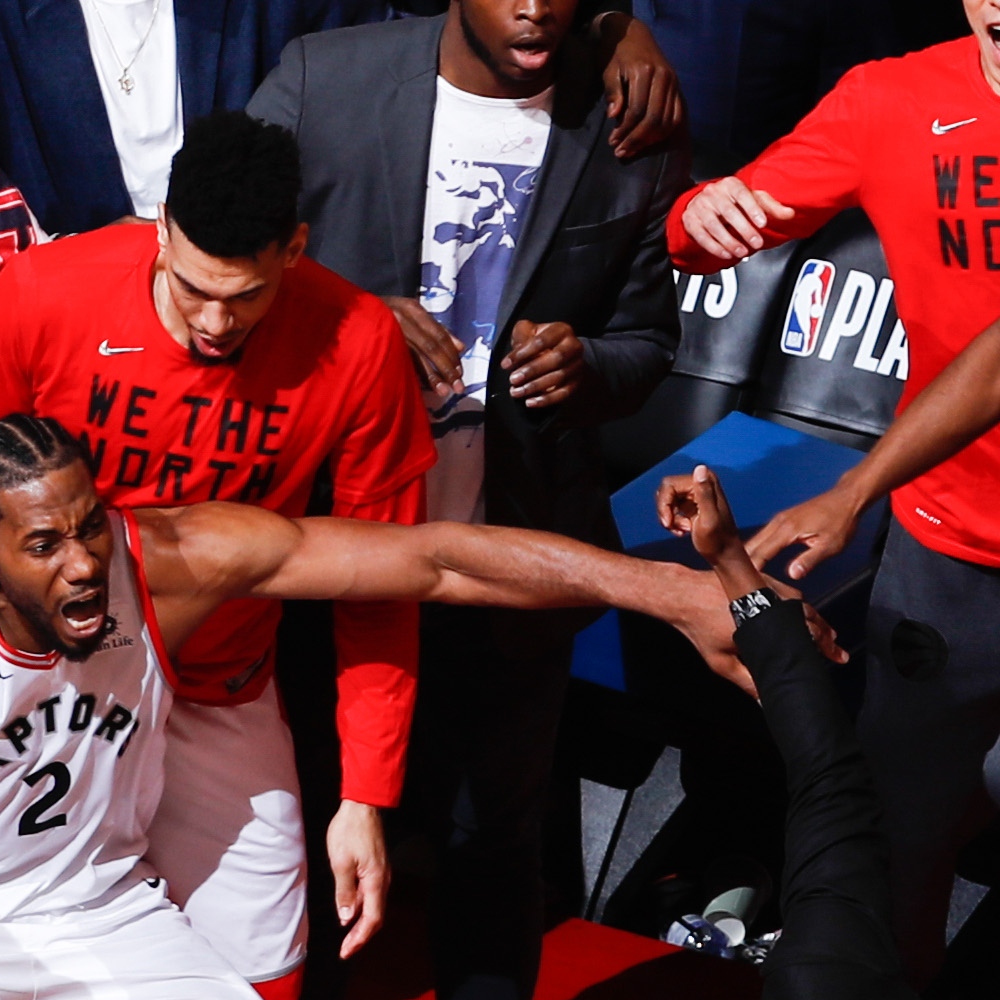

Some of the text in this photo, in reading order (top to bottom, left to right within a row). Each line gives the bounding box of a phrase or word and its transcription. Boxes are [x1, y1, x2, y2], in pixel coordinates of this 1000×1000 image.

[932, 154, 1000, 209] WE
[86, 373, 289, 456] WE THE
[79, 430, 277, 500] NORTH
[18, 761, 71, 836] 2
